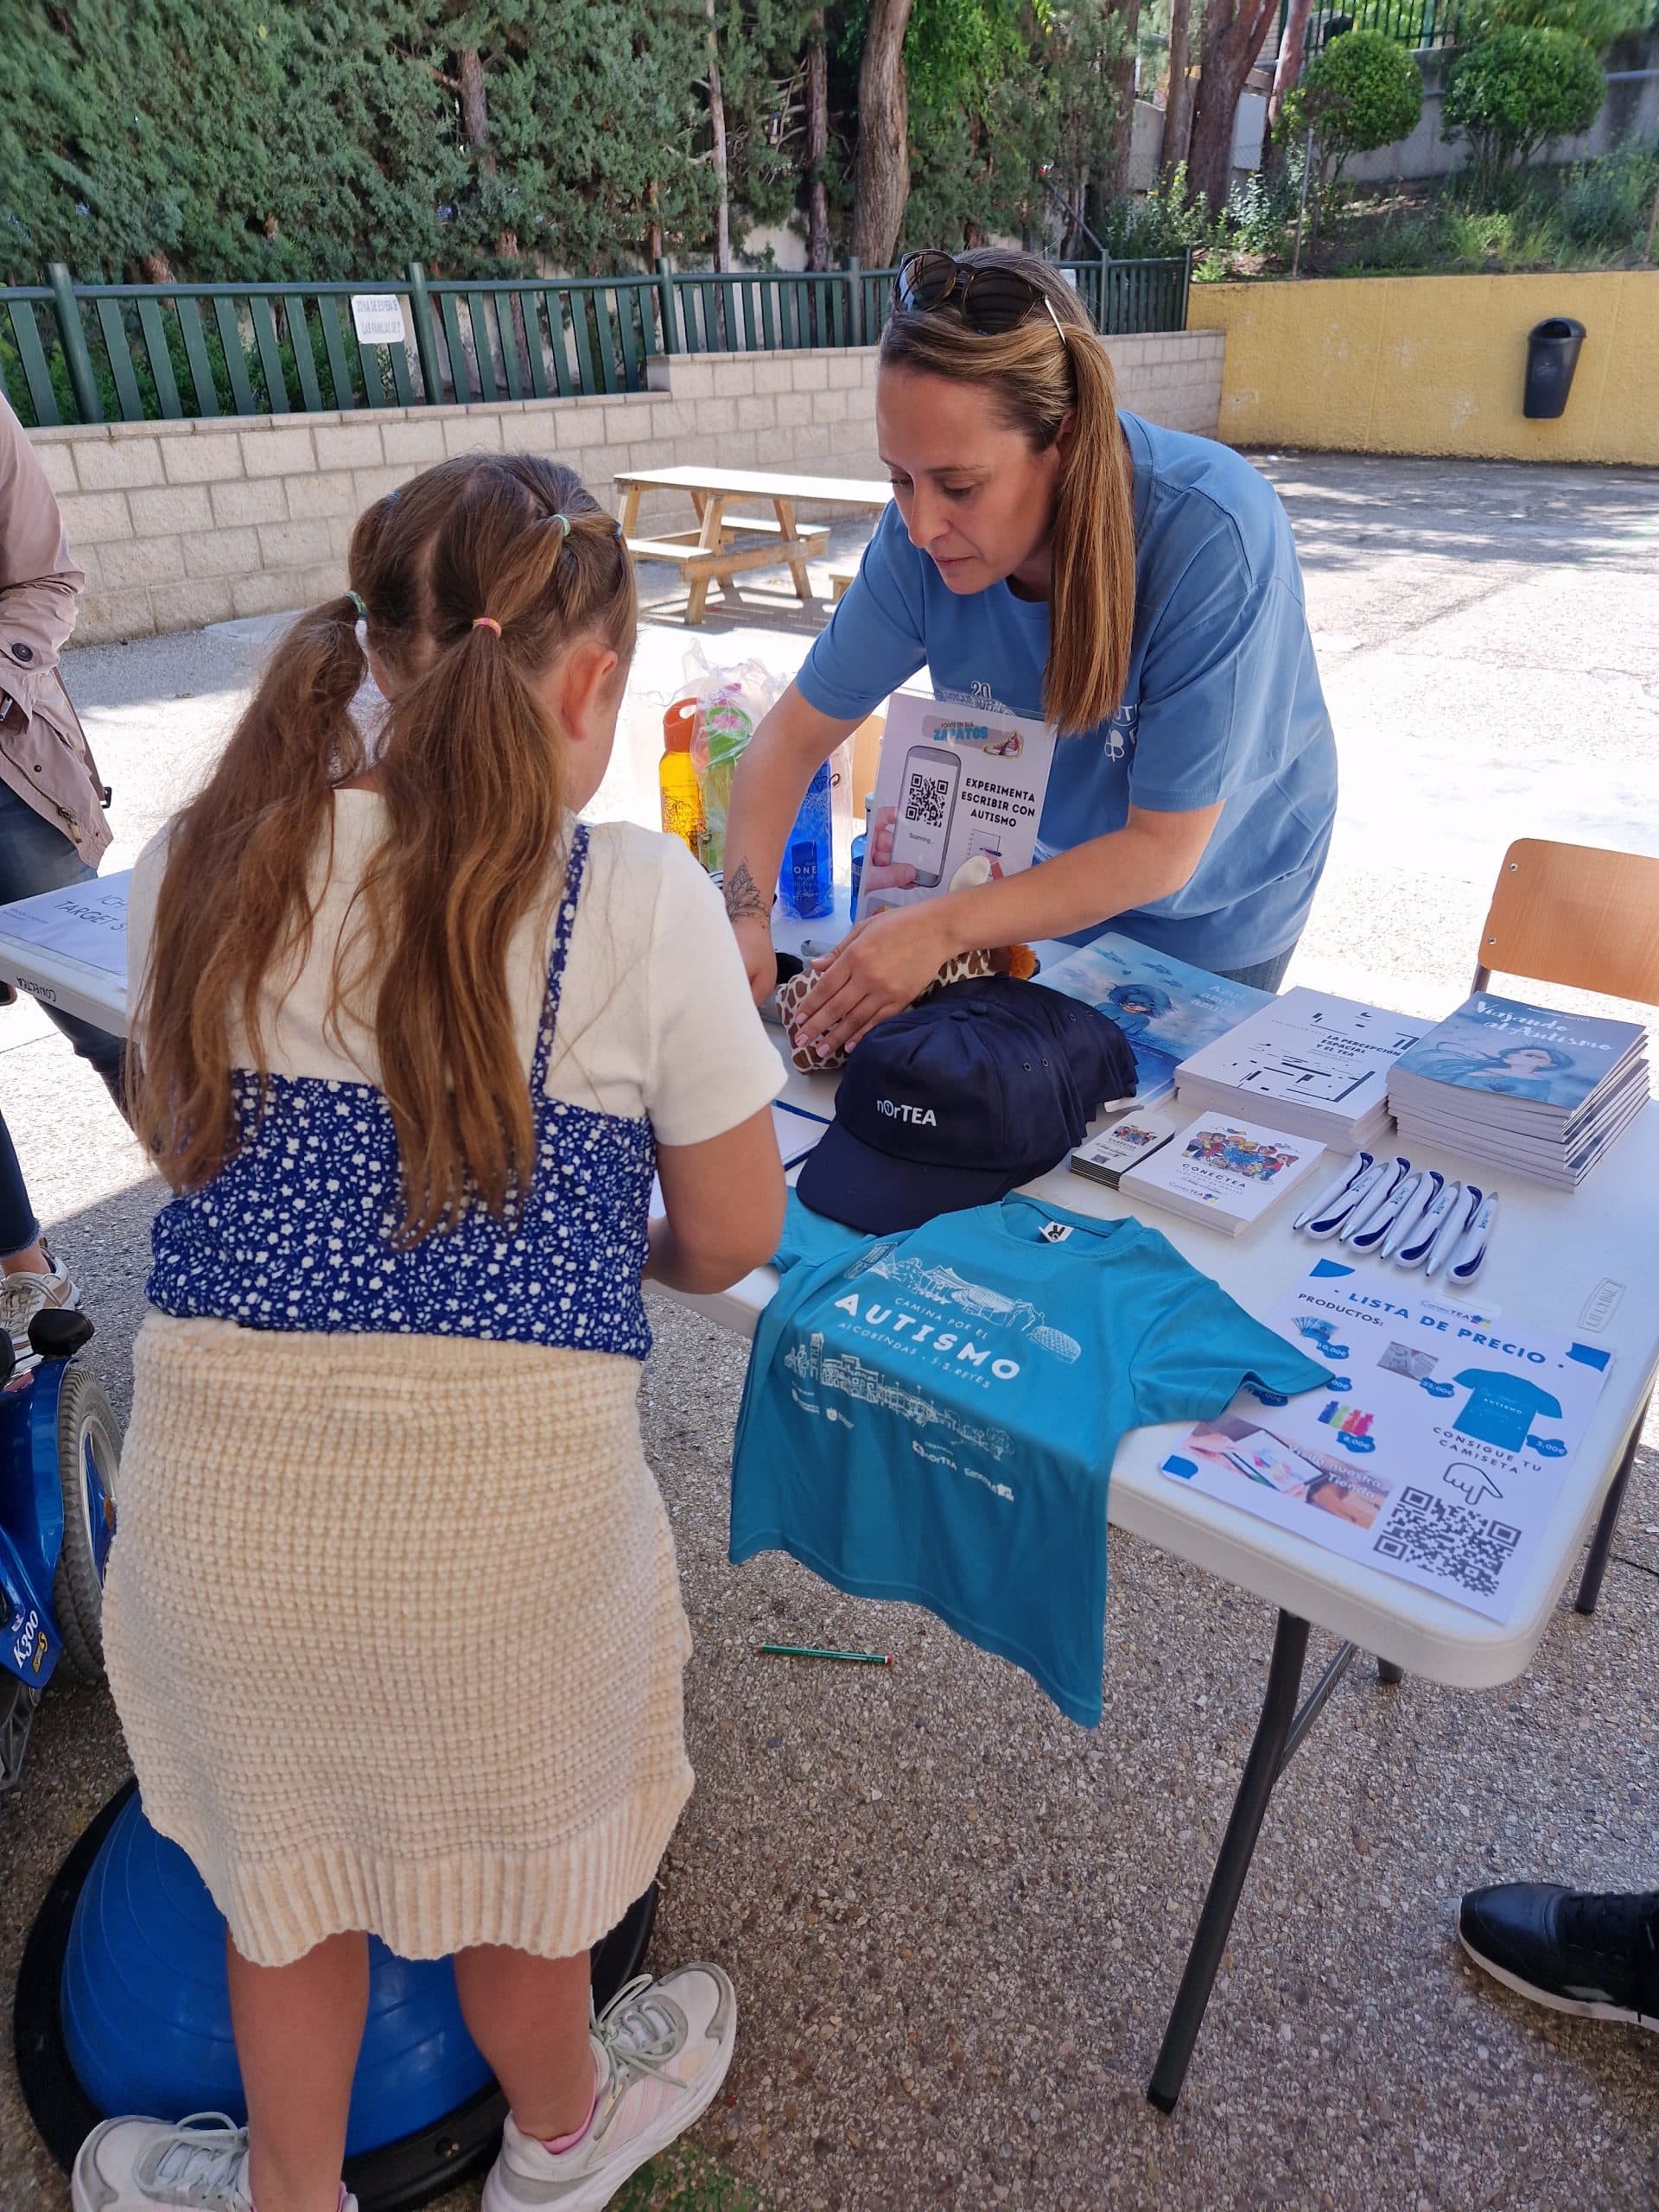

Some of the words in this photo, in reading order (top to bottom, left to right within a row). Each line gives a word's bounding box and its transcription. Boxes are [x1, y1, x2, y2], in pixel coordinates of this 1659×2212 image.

[966, 778, 1035, 802] EXPERIMENTA
[961, 791, 1009, 811] ESCRIBIR
[1012, 804, 1035, 817] CON
[970, 809, 1017, 828] AUTISMO
[54, 900, 119, 925] TARGET
[1477, 1001, 1572, 1032] Viajando
[1320, 1039, 1367, 1055] ESPACIAL
[1338, 1049, 1355, 1058] TEA
[1339, 1039, 1402, 1057] PERCEPCIÓN
[1182, 1163, 1246, 1188] CONECTEA
[895, 1297, 942, 1321] CAMINA
[947, 1319, 972, 1331] POR
[976, 1328, 988, 1340] EL
[1298, 1293, 1383, 1326] PRODUCTOS:
[834, 1293, 1020, 1380] AUTISMO
[1348, 1293, 1409, 1319] LISTA
[1419, 1315, 1450, 1332] DE
[1457, 1328, 1547, 1364] PRECIO
[1483, 1398, 1522, 1414] AUTISMO
[1433, 1427, 1514, 1461] CONSIGUE
[1522, 1460, 1542, 1471] TU
[1439, 1440, 1518, 1474] CAMISETA
[1328, 1471, 1375, 1499] Tienda
[13, 1610, 39, 1669] K300
